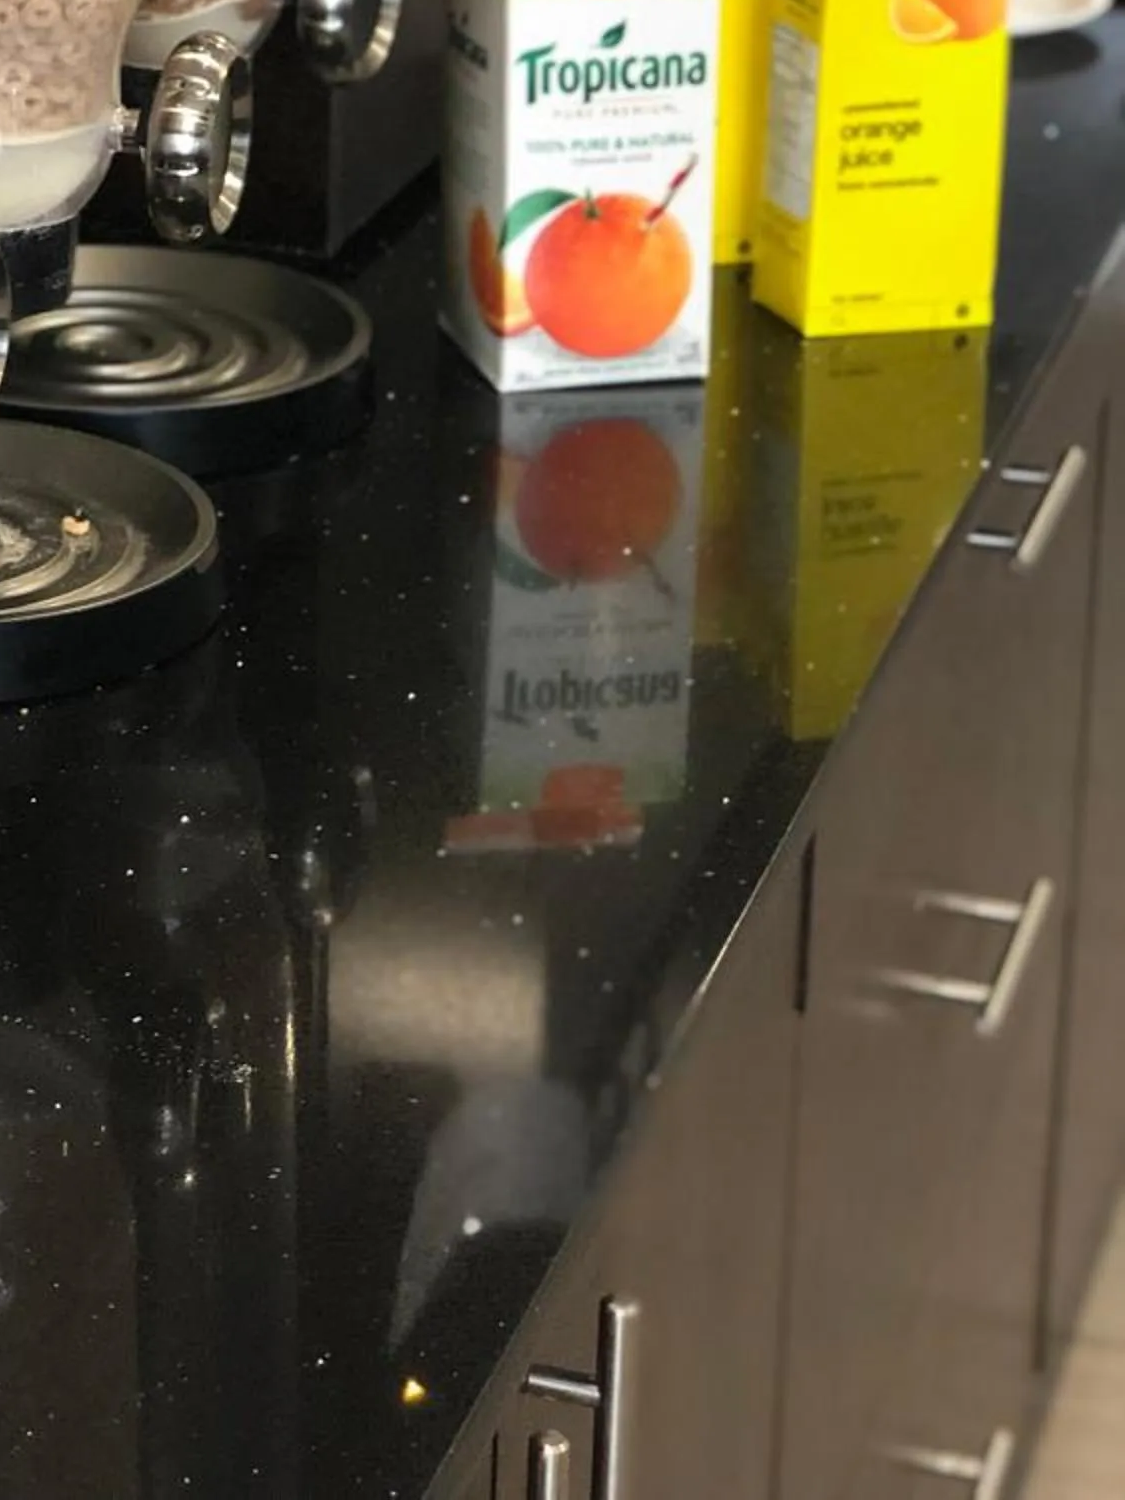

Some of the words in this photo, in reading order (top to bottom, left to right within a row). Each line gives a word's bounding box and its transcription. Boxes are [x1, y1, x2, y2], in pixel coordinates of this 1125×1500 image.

[516, 41, 707, 105] Tropicana
[839, 120, 922, 143] orange
[837, 146, 894, 175] juice
